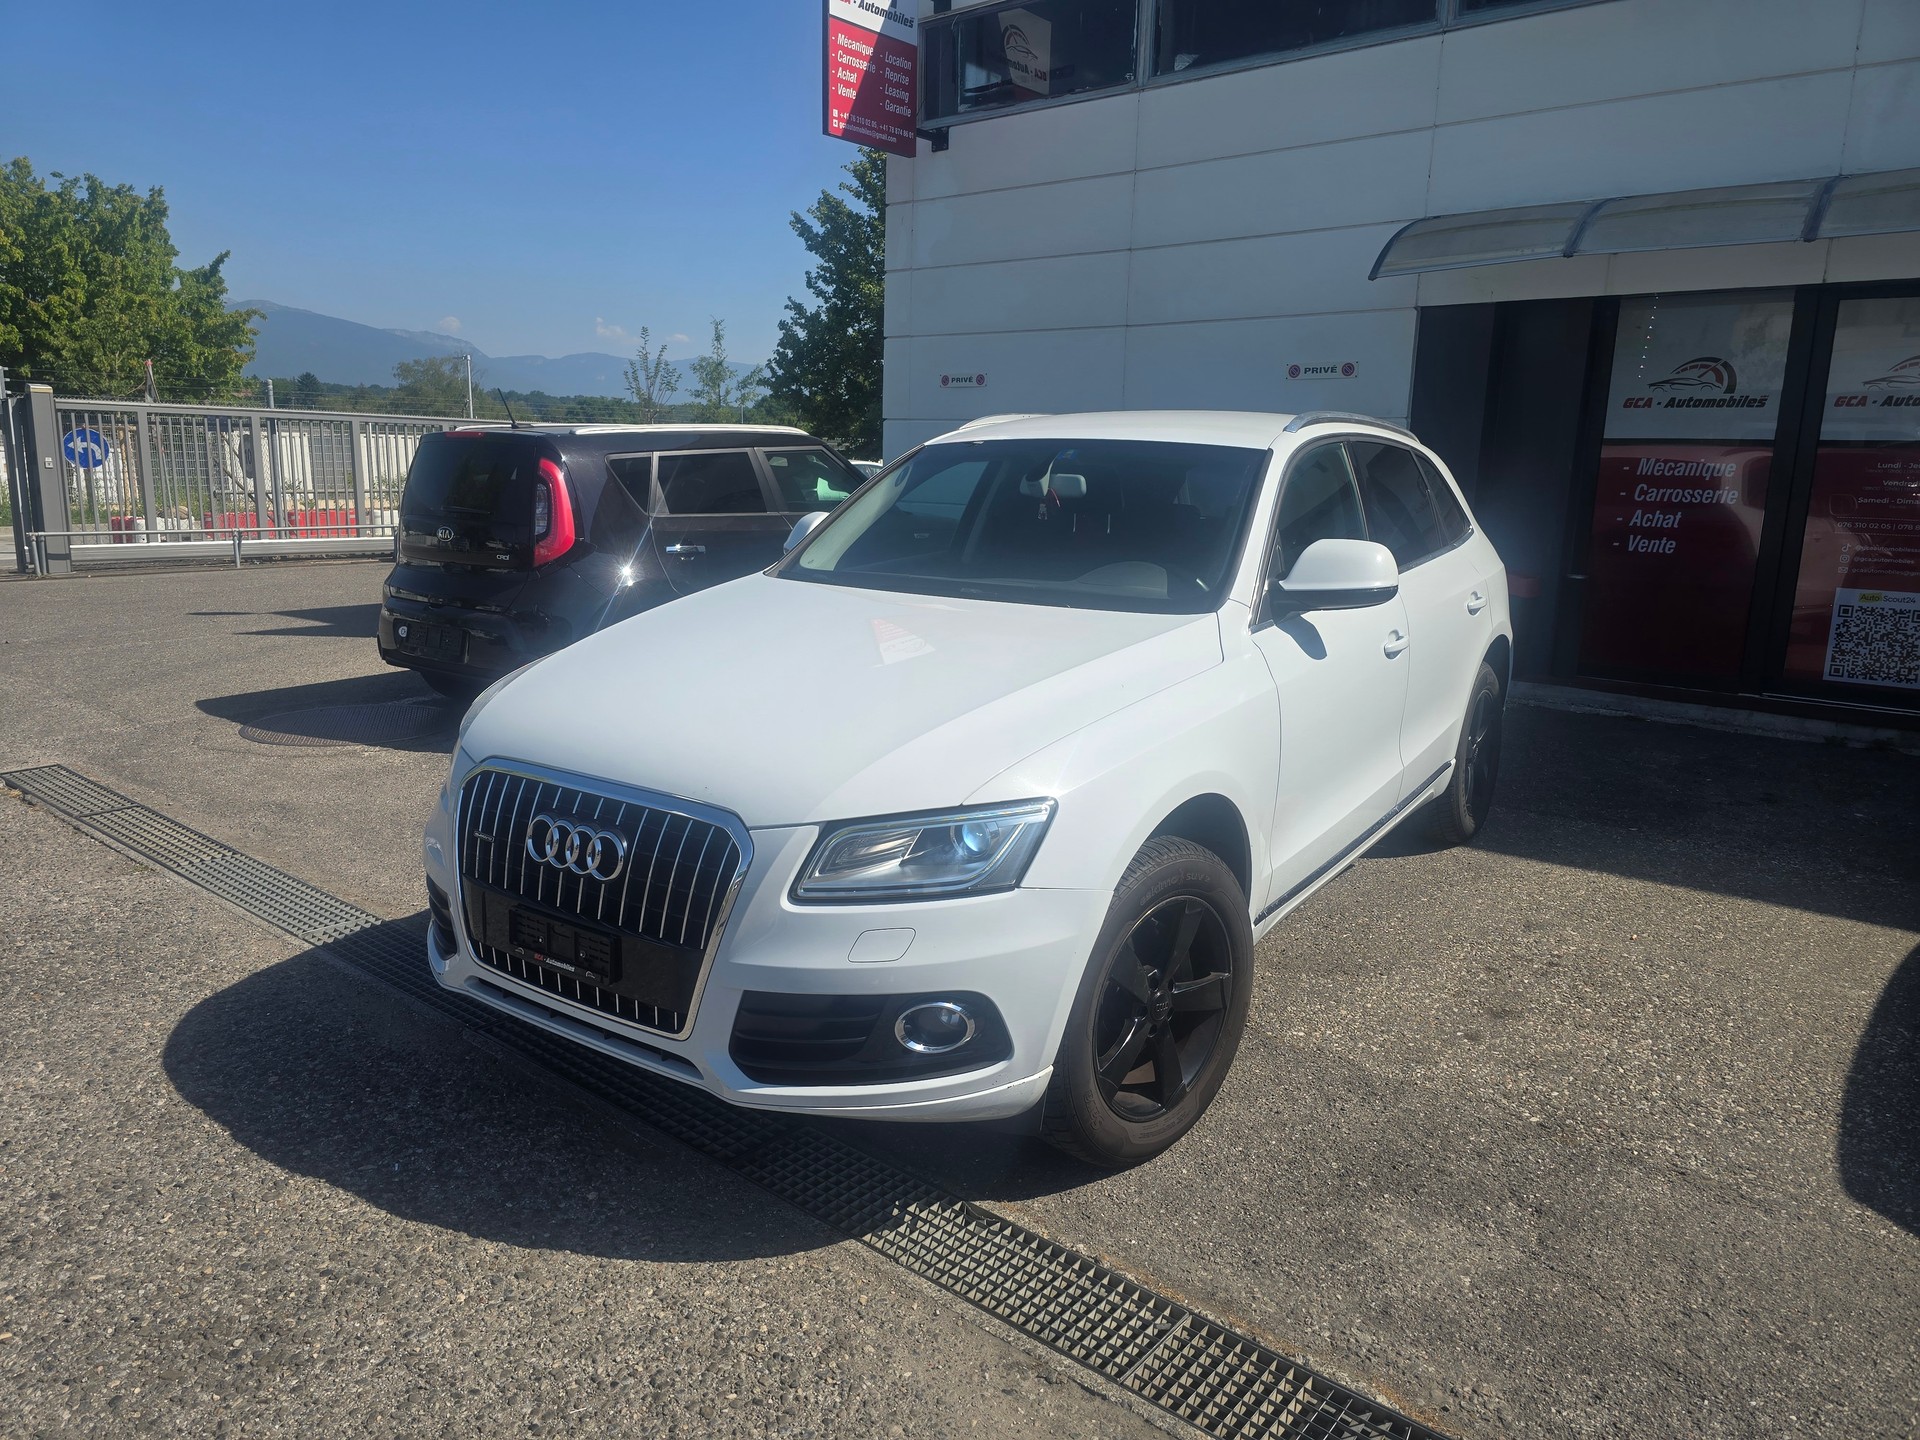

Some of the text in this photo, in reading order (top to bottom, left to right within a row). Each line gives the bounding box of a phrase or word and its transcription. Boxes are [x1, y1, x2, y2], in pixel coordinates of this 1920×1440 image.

[858, 0, 914, 28] Automobiles
[837, 33, 874, 56] Mécanique
[837, 50, 876, 73] Carrosserie
[885, 52, 912, 70] Location
[837, 67, 857, 83] Achat
[885, 68, 910, 85] Reprise
[837, 83, 857, 99] Vente
[885, 84, 910, 103] Leasing
[885, 100, 912, 117] Garantie
[1304, 364, 1338, 374] PRIVÉ
[1622, 397, 1653, 408] GCA
[1663, 395, 1768, 409] Automobiles
[1834, 395, 1868, 407] GCA
[1636, 458, 1737, 480] Mécanique
[1634, 483, 1739, 505] Carrosserie
[1857, 496, 1889, 504] Samedi
[1628, 509, 1682, 529] Achat
[1627, 534, 1677, 554] Vente
